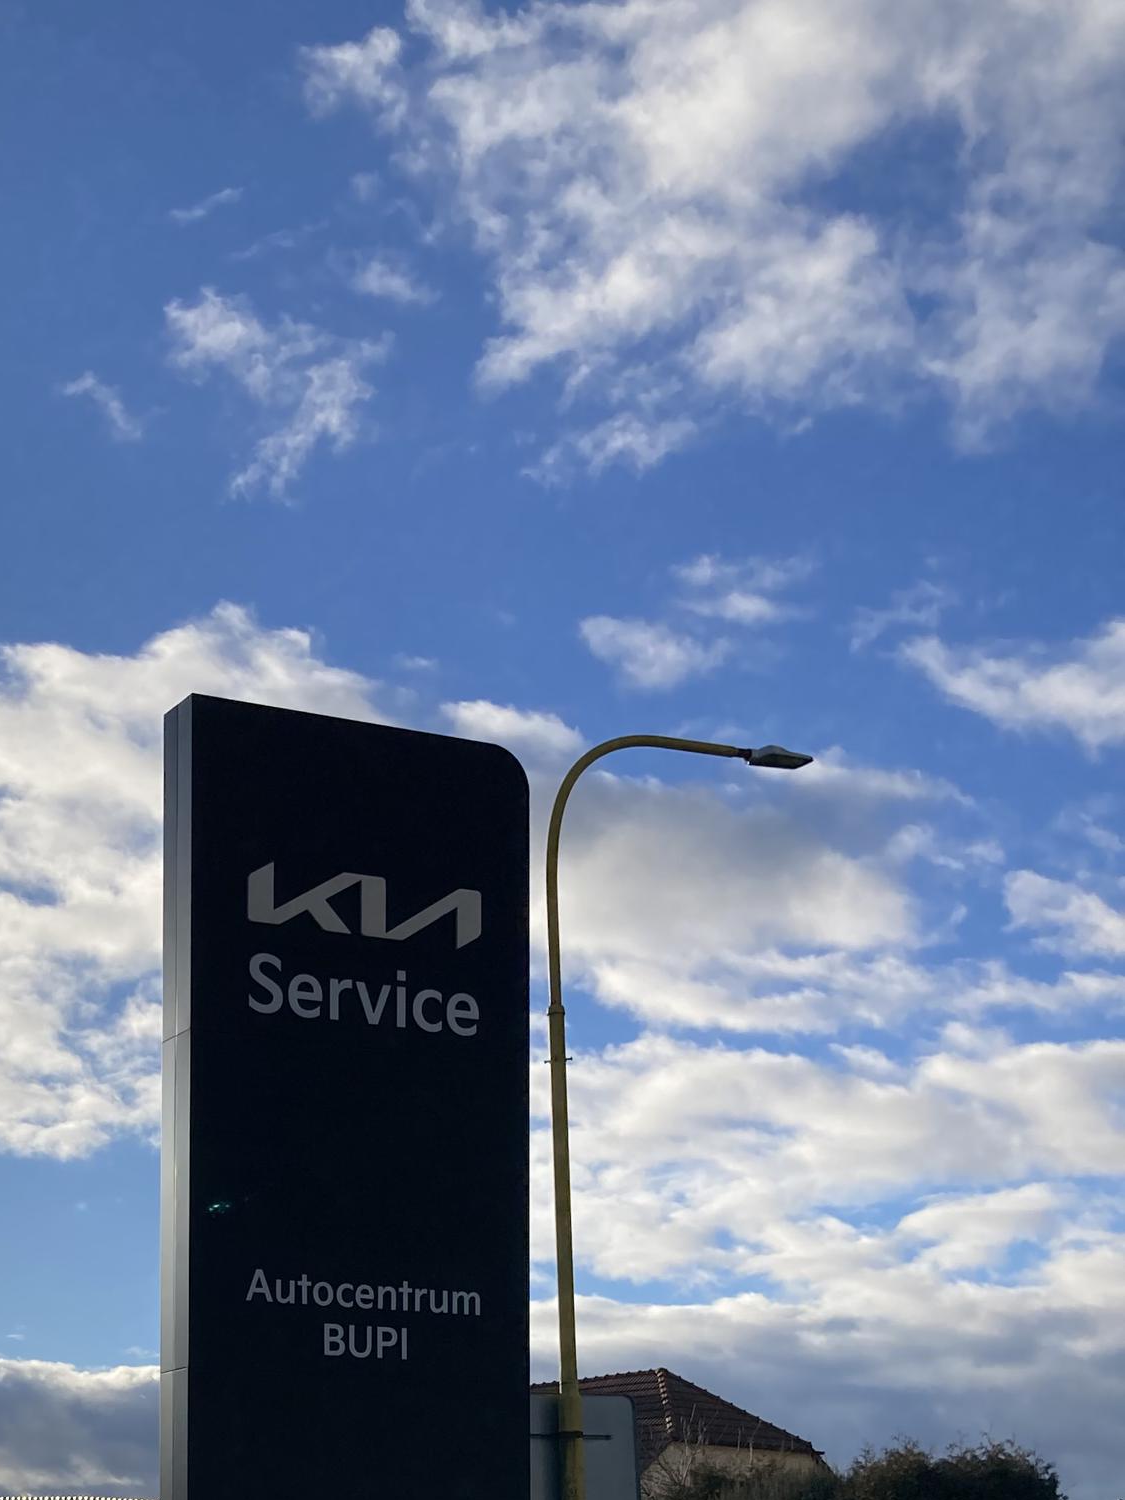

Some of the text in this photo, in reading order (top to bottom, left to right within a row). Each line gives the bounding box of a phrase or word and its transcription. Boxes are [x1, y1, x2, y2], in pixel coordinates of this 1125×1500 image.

[246, 861, 482, 949] KIA
[247, 952, 480, 1037] Service
[246, 1268, 482, 1317] Autocentrum
[323, 1322, 409, 1361] BUPI
